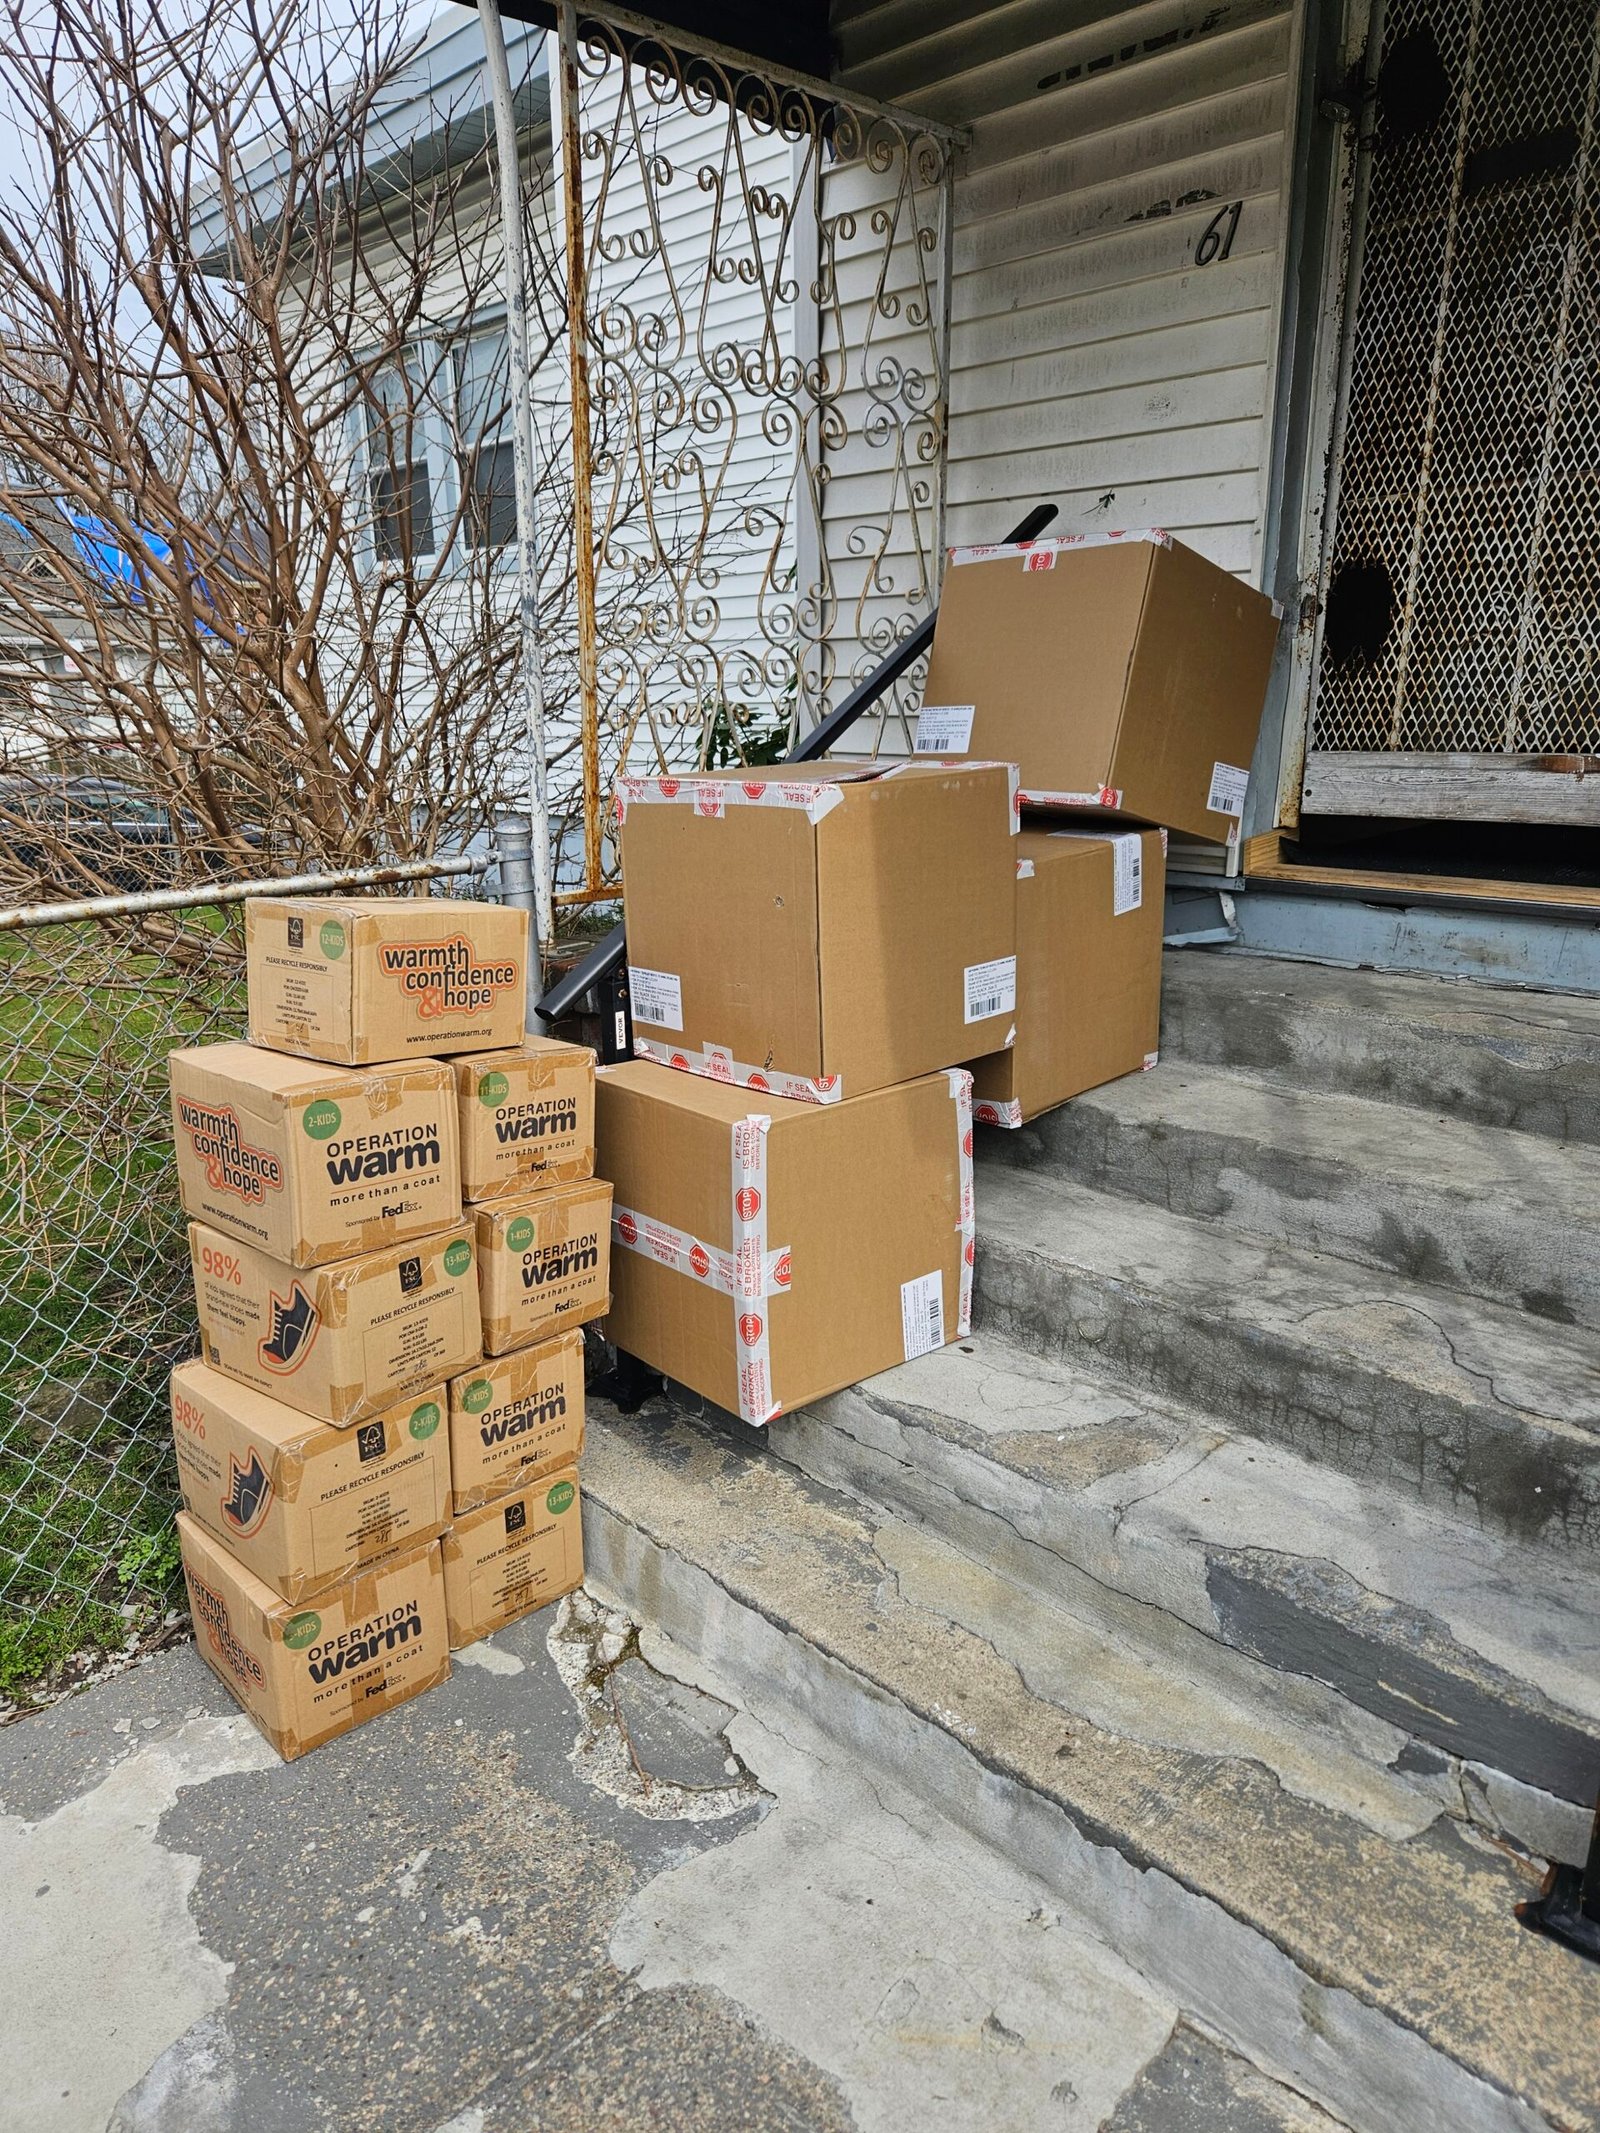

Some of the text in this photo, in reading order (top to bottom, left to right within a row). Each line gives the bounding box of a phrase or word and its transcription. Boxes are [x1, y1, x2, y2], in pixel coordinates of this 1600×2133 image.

[1195, 201, 1243, 266] 61
[784, 793, 805, 803] SEAL
[265, 956, 281, 964] PLEASE
[385, 941, 469, 969] warmth
[406, 962, 514, 990] confidence
[419, 986, 491, 1018] & hope
[406, 1028, 493, 1044] www.operationwarm.org
[712, 1064, 731, 1074] SEAL
[786, 1081, 793, 1089] IF
[179, 1103, 238, 1141] warmth
[308, 1111, 337, 1128] 2-KIDS
[495, 1097, 576, 1121] OPERATION
[326, 1123, 438, 1158] OPERATION
[495, 1110, 576, 1143] warm
[194, 1131, 279, 1181] confidence
[326, 1139, 440, 1185] warm
[496, 1150, 520, 1160] more
[522, 1146, 544, 1155] than
[555, 1139, 575, 1149] coat
[743, 1159, 750, 1170] IS
[207, 1157, 260, 1196] & hope
[330, 1174, 440, 1207] more than a coat
[742, 1190, 752, 1218] STOP
[202, 1203, 269, 1241] www.operationwarm.org
[446, 1250, 470, 1267] 13-KIDS
[522, 1233, 598, 1266] OPERATION
[652, 1247, 669, 1260] SEAL
[692, 1255, 707, 1269] STOP
[202, 1247, 242, 1286] 98%
[521, 1246, 598, 1288] warm
[744, 1238, 752, 1297] IS BROKEN
[370, 1311, 392, 1326] PLEASE
[393, 1302, 418, 1317] RECYCLE
[418, 1286, 455, 1307] RESPONSIBLY
[521, 1294, 545, 1306] more
[547, 1287, 568, 1298] than
[577, 1275, 596, 1287] coat
[745, 1317, 754, 1343] STOP
[175, 1394, 206, 1440] 98%
[480, 1382, 564, 1425] OPERATION
[749, 1408, 756, 1417] IS
[413, 1412, 437, 1431] 2-KIDS
[480, 1395, 566, 1447] warm
[482, 1449, 509, 1464] more
[511, 1439, 534, 1453] than
[545, 1423, 566, 1438] coat
[320, 1484, 348, 1501] PLEASE
[349, 1471, 380, 1490] RECYCLE
[380, 1451, 425, 1477] RESPONSIBLY
[549, 1489, 574, 1506] 13-KIDS
[476, 1551, 497, 1565] PLEASE
[498, 1540, 521, 1555] RECYCLE
[521, 1523, 557, 1543] RESPONSIBLY
[308, 1600, 418, 1661] OPERATION
[308, 1614, 422, 1684] warm
[314, 1644, 423, 1703] more than a coat
